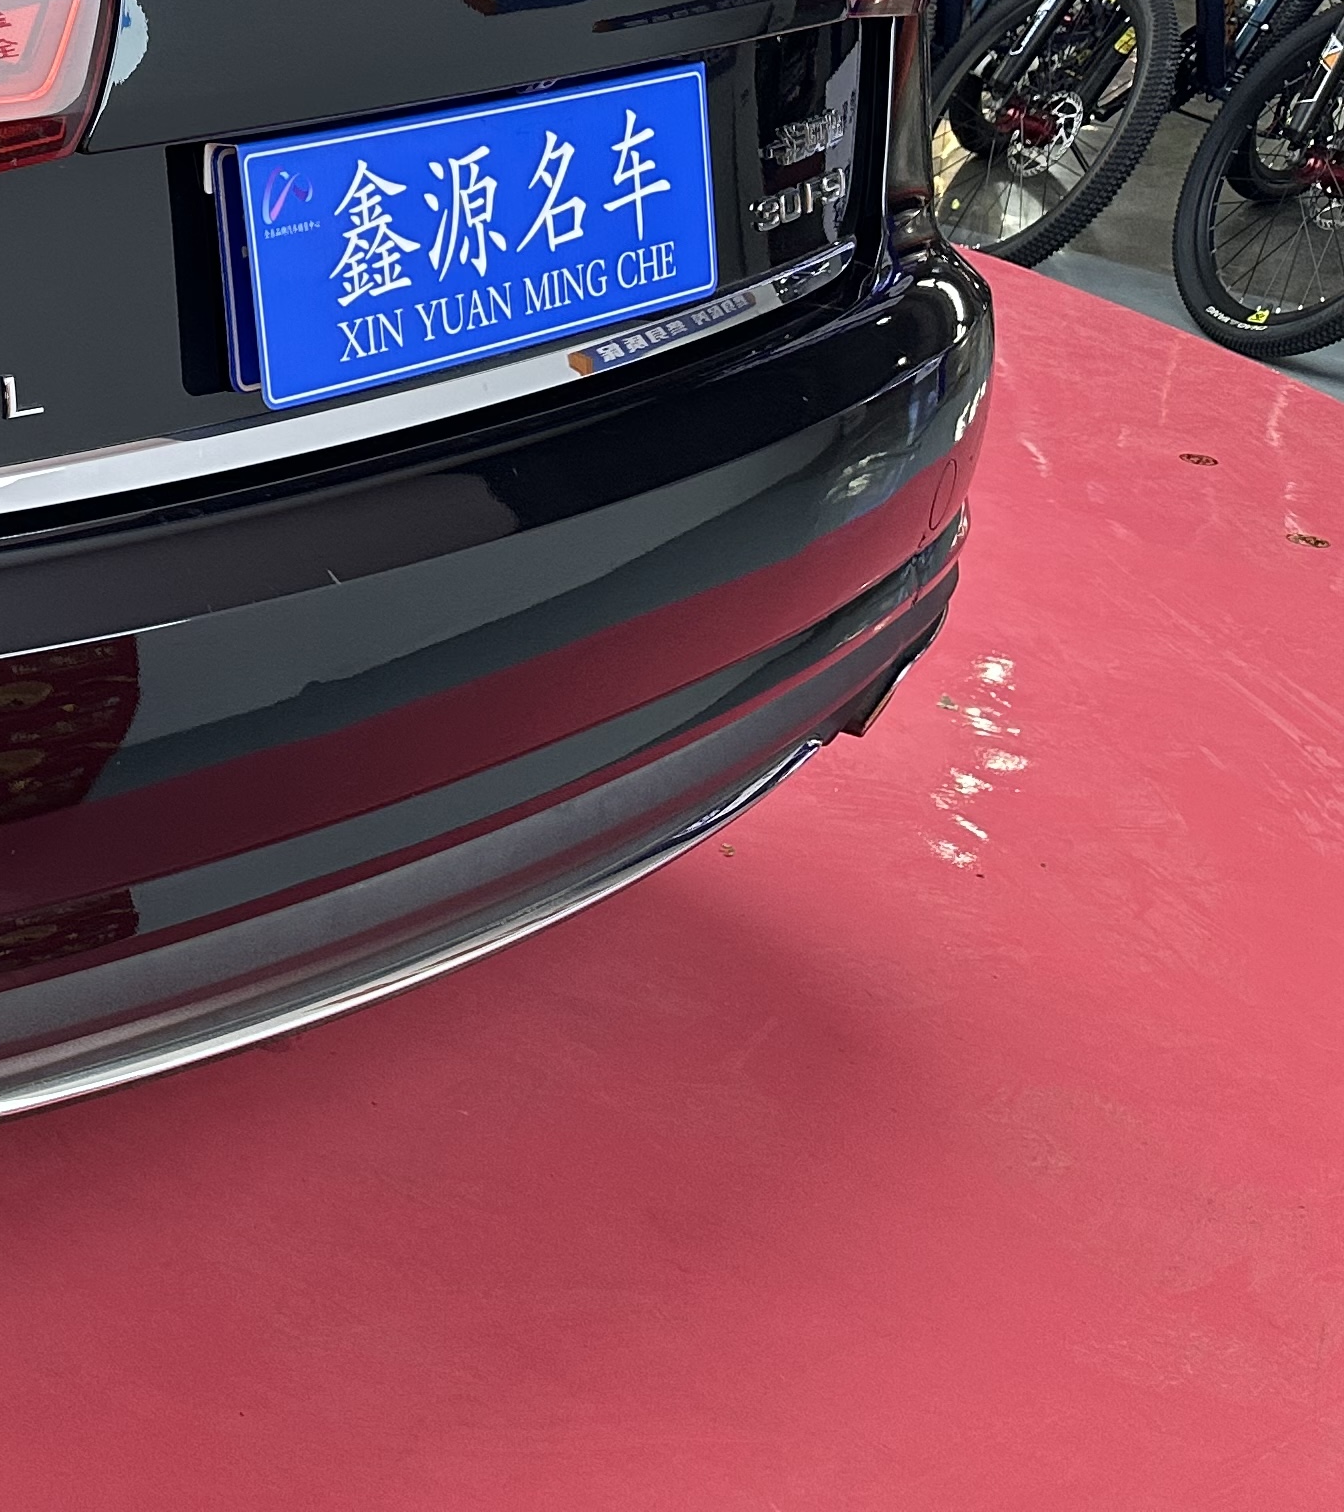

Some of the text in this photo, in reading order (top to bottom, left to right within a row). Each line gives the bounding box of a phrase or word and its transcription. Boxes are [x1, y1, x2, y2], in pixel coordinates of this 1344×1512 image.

[328, 107, 672, 308] 鑫源名车
[337, 239, 678, 363] XIN YUAN MING CHE
